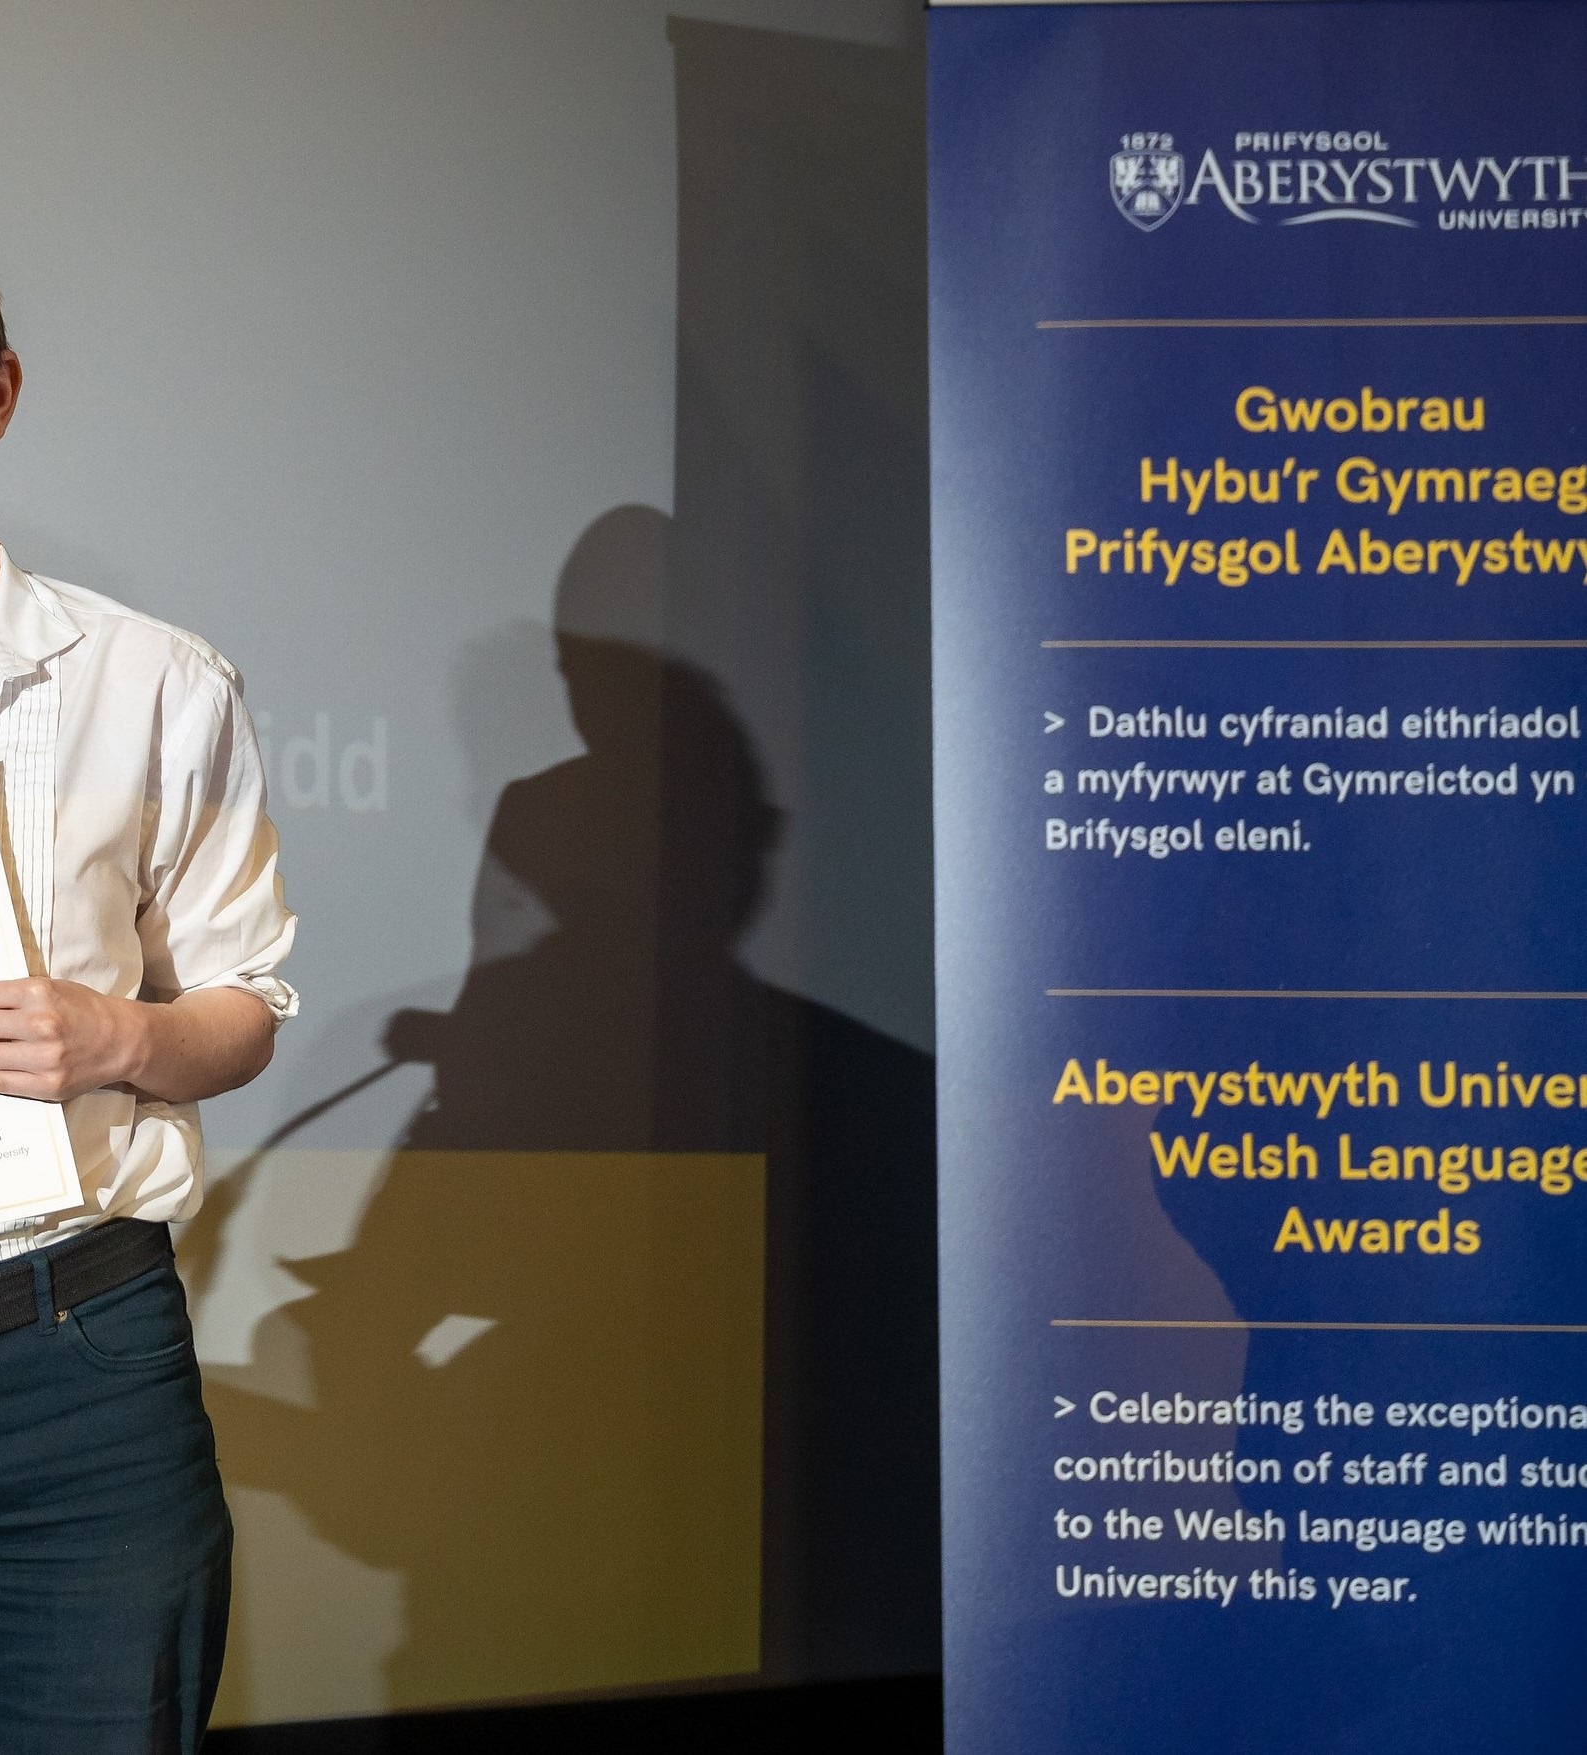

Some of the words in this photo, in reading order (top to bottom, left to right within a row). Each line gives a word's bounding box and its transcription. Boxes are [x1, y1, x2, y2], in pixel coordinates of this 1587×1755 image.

[1120, 132, 1174, 154] 1872
[1234, 131, 1388, 152] PRIFYSGOL
[1185, 148, 1587, 224] ABERYSTWYTH
[1437, 208, 1587, 231] UNIVERSIT
[1235, 386, 1485, 433] Gwobrau
[1140, 457, 1319, 515] Hybu'r
[1335, 456, 1587, 516] Gymraeg
[1065, 527, 1301, 587] Prifysgol
[1088, 705, 1207, 738] Dathlu
[1219, 705, 1389, 746] cyfraniad
[1401, 706, 1580, 739] eithriadol
[1043, 769, 1065, 794] a
[1077, 761, 1246, 803] myfyrwyr
[1256, 764, 1292, 795] at
[1303, 762, 1518, 804] Gymreictod
[1530, 770, 1575, 803] yn
[1044, 817, 1204, 859] Brifysgol
[1214, 819, 1311, 852] eleni.
[1051, 1057, 1399, 1119] Aberystwyth
[1148, 1131, 1318, 1180] Welsh
[1273, 1206, 1481, 1255] Awards
[1089, 1390, 1305, 1434] Celebrating
[1313, 1393, 1375, 1427] the
[1385, 1395, 1587, 1437] exceptiona
[1053, 1449, 1281, 1483] contribution
[1293, 1451, 1332, 1484] of
[1343, 1452, 1428, 1485] staff
[1438, 1454, 1507, 1487] and
[1053, 1508, 1093, 1540] to
[1103, 1507, 1164, 1541] the
[1173, 1508, 1286, 1542] Welsh
[1299, 1509, 1467, 1553] language
[1476, 1512, 1587, 1546] within
[1055, 1564, 1238, 1607] University
[1247, 1567, 1317, 1601] this
[1327, 1576, 1417, 1609] year.
